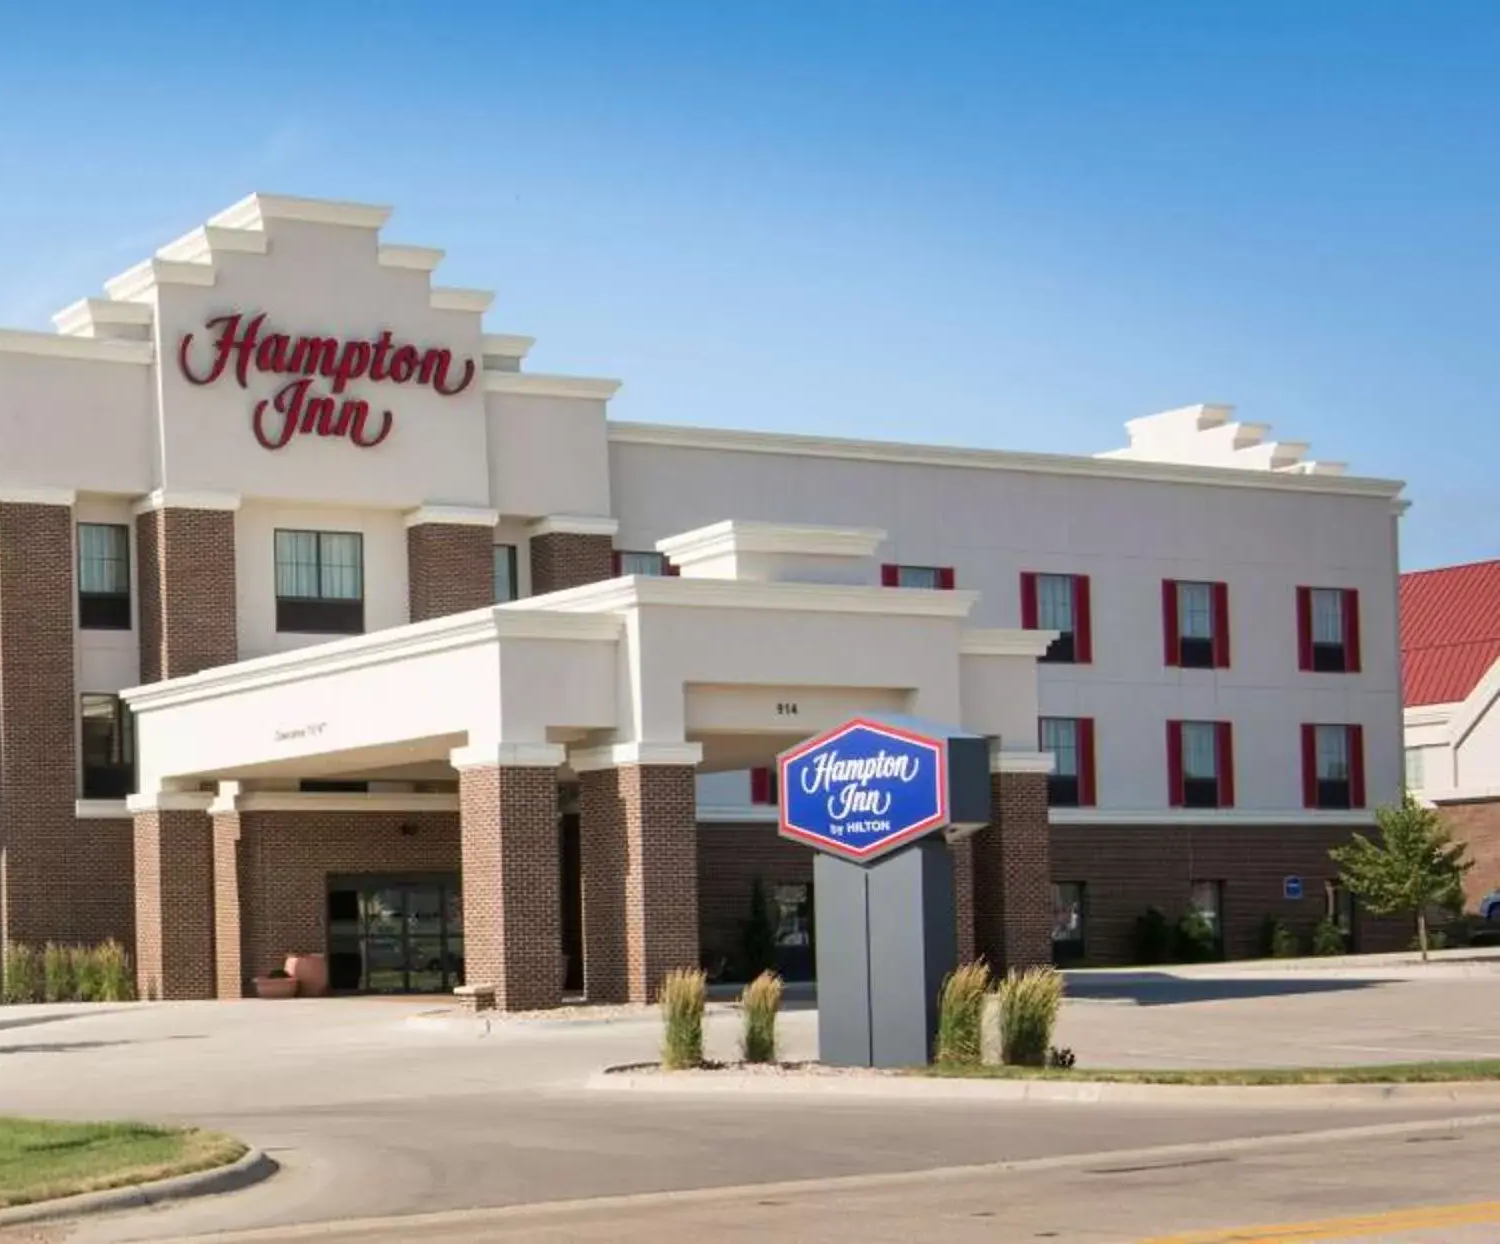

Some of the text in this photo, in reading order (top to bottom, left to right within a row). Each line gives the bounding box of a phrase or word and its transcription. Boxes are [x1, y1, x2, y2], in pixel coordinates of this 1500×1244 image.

[179, 312, 475, 396] Hampton
[253, 378, 393, 451] Inn
[776, 703, 798, 715] 914
[801, 750, 919, 794] Hampton
[827, 783, 891, 820] Inn
[829, 820, 891, 836] by HILTON
